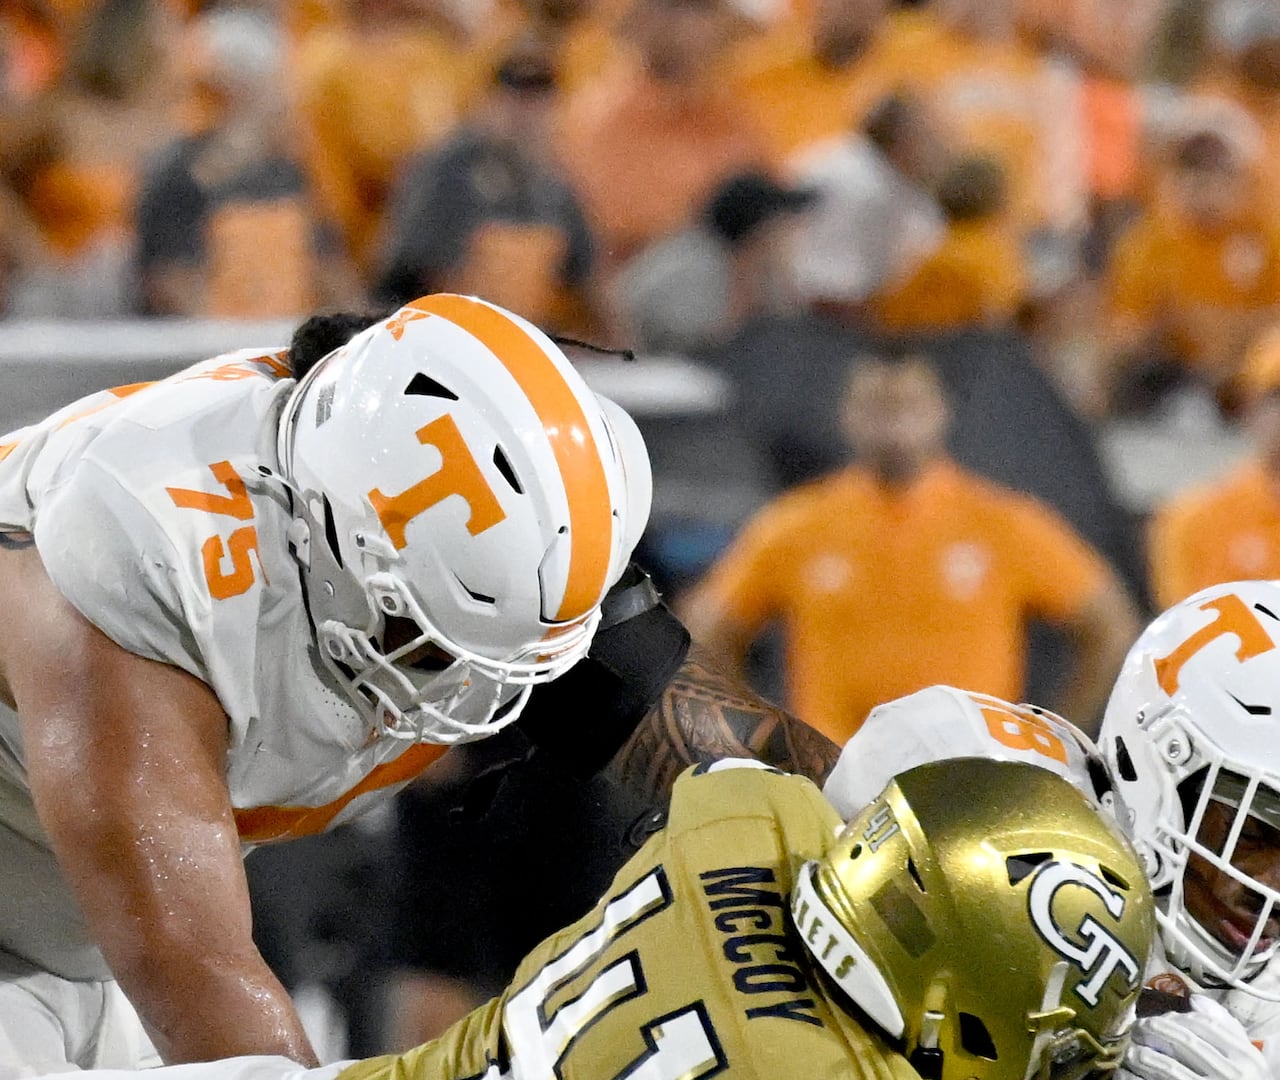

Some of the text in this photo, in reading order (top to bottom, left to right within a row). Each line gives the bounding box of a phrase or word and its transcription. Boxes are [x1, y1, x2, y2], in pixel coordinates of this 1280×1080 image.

[164, 460, 257, 600] 75
[366, 412, 507, 552] T
[1153, 592, 1277, 698] T
[1026, 860, 1141, 1010] GT
